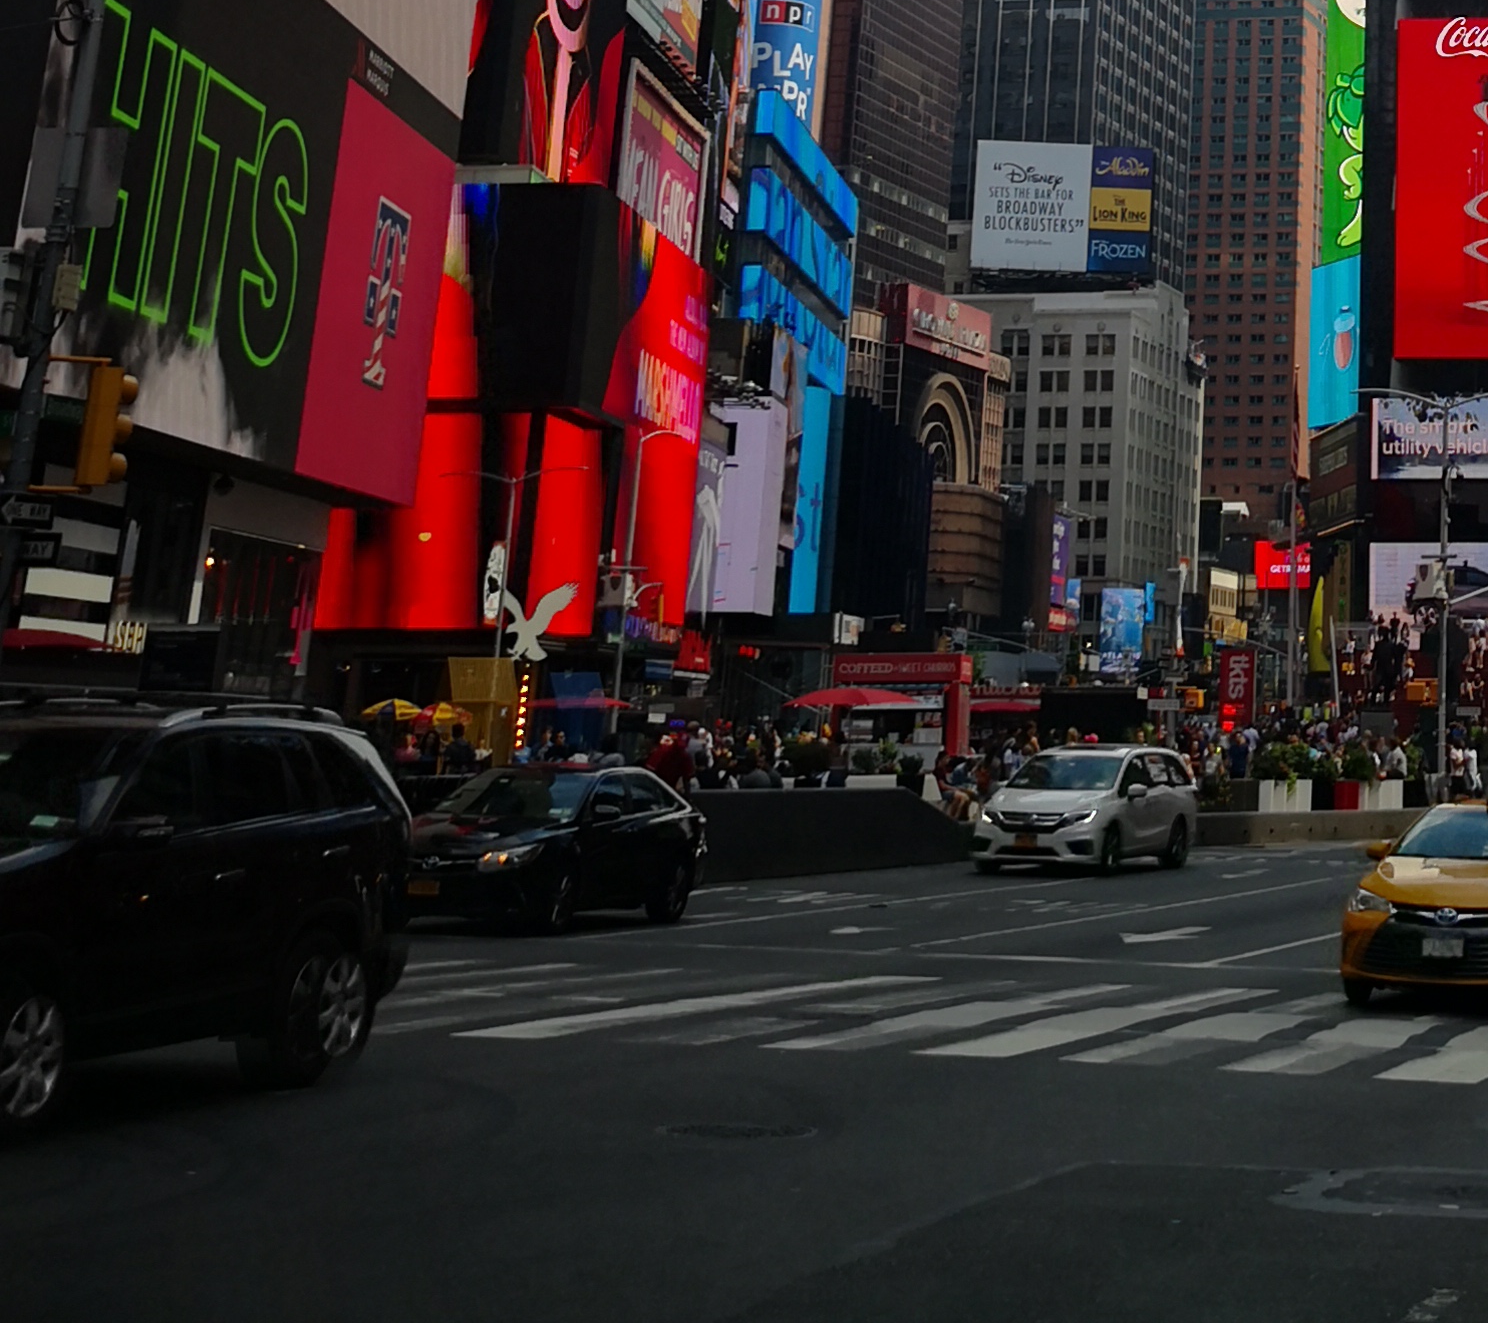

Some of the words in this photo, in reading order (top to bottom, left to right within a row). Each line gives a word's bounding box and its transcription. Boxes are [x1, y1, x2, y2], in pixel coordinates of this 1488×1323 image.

[765, 3, 813, 25] npr
[752, 41, 814, 81] PLAY
[989, 187, 1010, 199] SETS
[1014, 187, 1030, 199] THE
[1034, 188, 1051, 200] BAR
[1055, 189, 1074, 201] FOR
[1114, 197, 1126, 206] THE
[996, 200, 1064, 216] BROADWAY
[1091, 239, 1147, 261] FROZEN
[1383, 418, 1415, 435] The
[1382, 439, 1431, 459] utility
[838, 662, 894, 674] COFFEED
[1227, 653, 1250, 701] tkts
